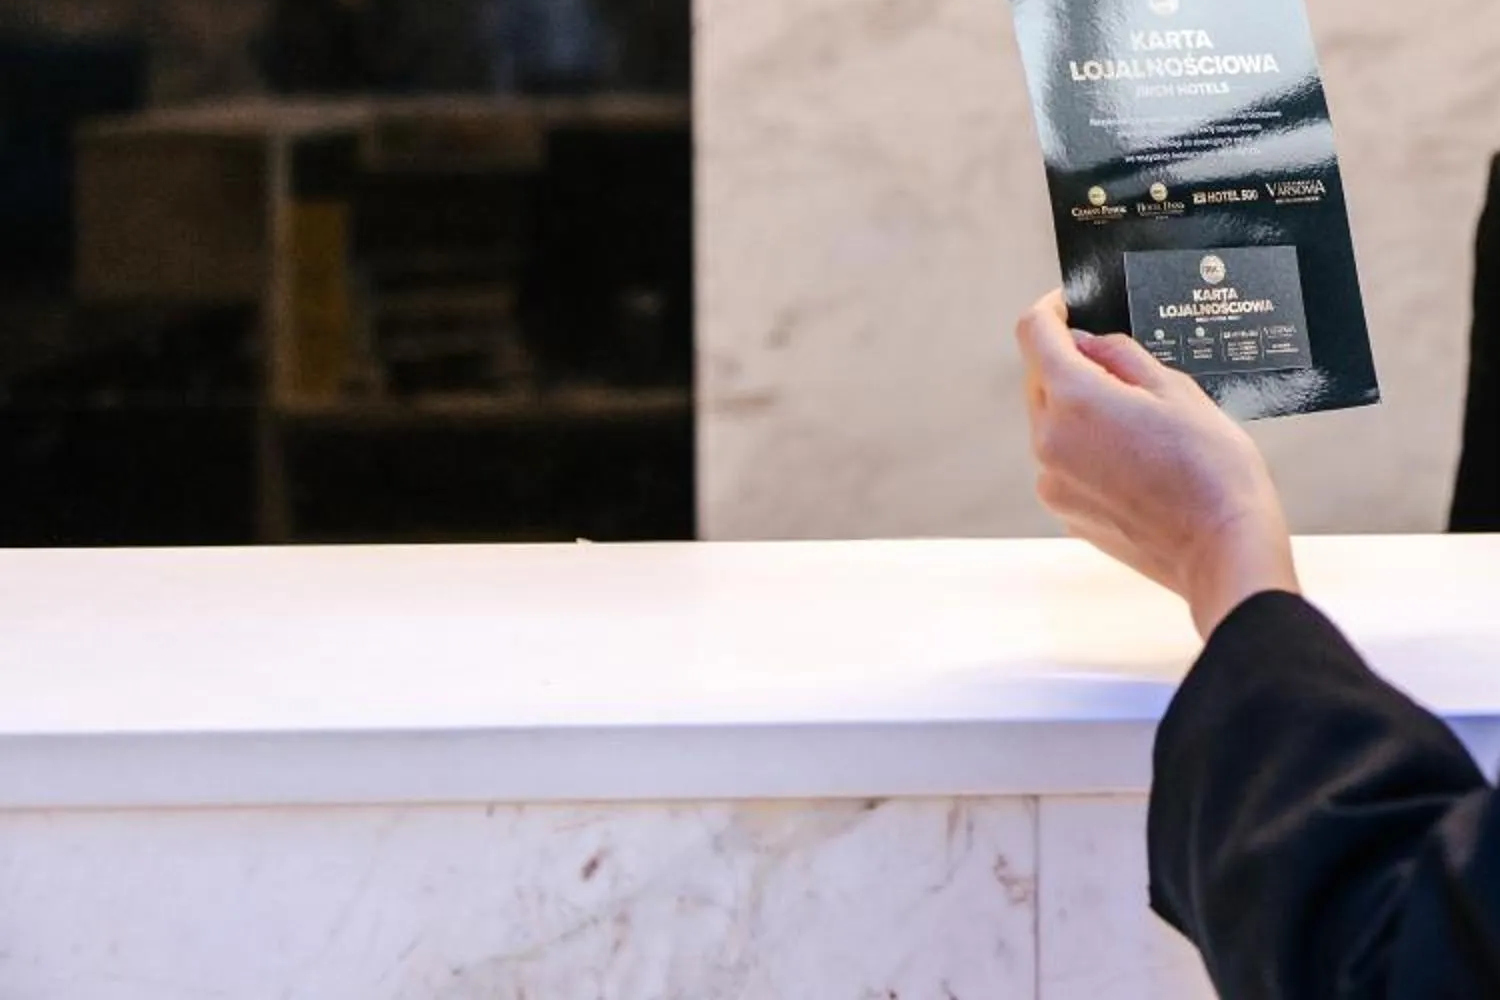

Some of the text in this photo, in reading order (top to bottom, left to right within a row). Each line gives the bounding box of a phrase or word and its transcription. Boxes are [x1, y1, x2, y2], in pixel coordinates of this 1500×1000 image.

[1131, 29, 1213, 50] KARTA
[1069, 52, 1279, 81] LOJALNOŚCIOWA
[1176, 81, 1230, 96] HOTELS
[1207, 189, 1259, 203] HOTEL 500
[1265, 179, 1326, 198] VARSOVIA
[1193, 287, 1239, 302] KARTA
[1159, 298, 1275, 319] LOJALNOŚCIOWA
